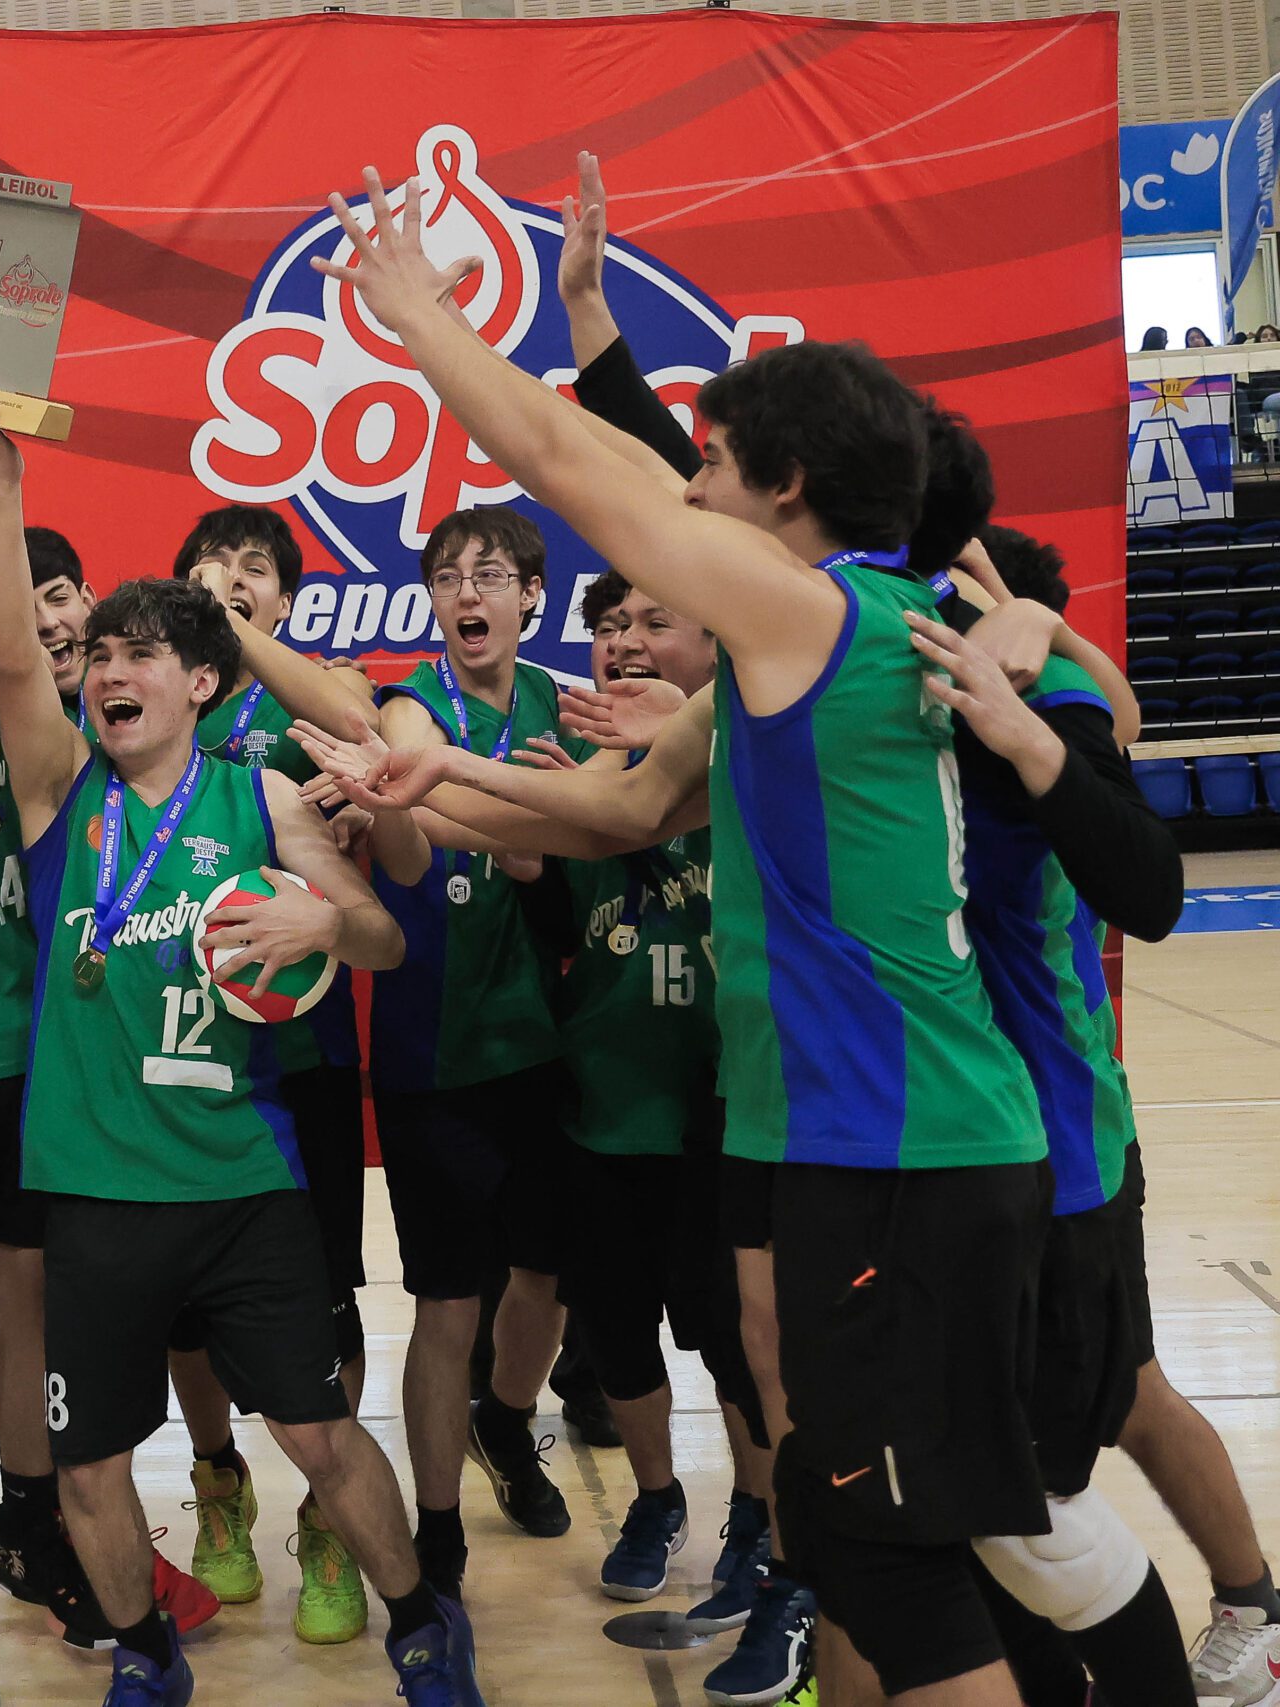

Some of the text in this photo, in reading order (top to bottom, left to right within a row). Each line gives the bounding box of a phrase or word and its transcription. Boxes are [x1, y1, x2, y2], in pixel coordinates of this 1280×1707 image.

[443, 672, 454, 689] COPA
[181, 785, 190, 795] UC
[169, 801, 183, 820] 2026
[102, 819, 116, 888] COPA SOPROLE UC
[183, 838, 230, 855] TERRAUSTRAL
[196, 848, 215, 857] OESTE
[119, 850, 158, 911] COPA SOPROLE UC
[648, 944, 695, 1006] 15
[161, 986, 216, 1055] 12
